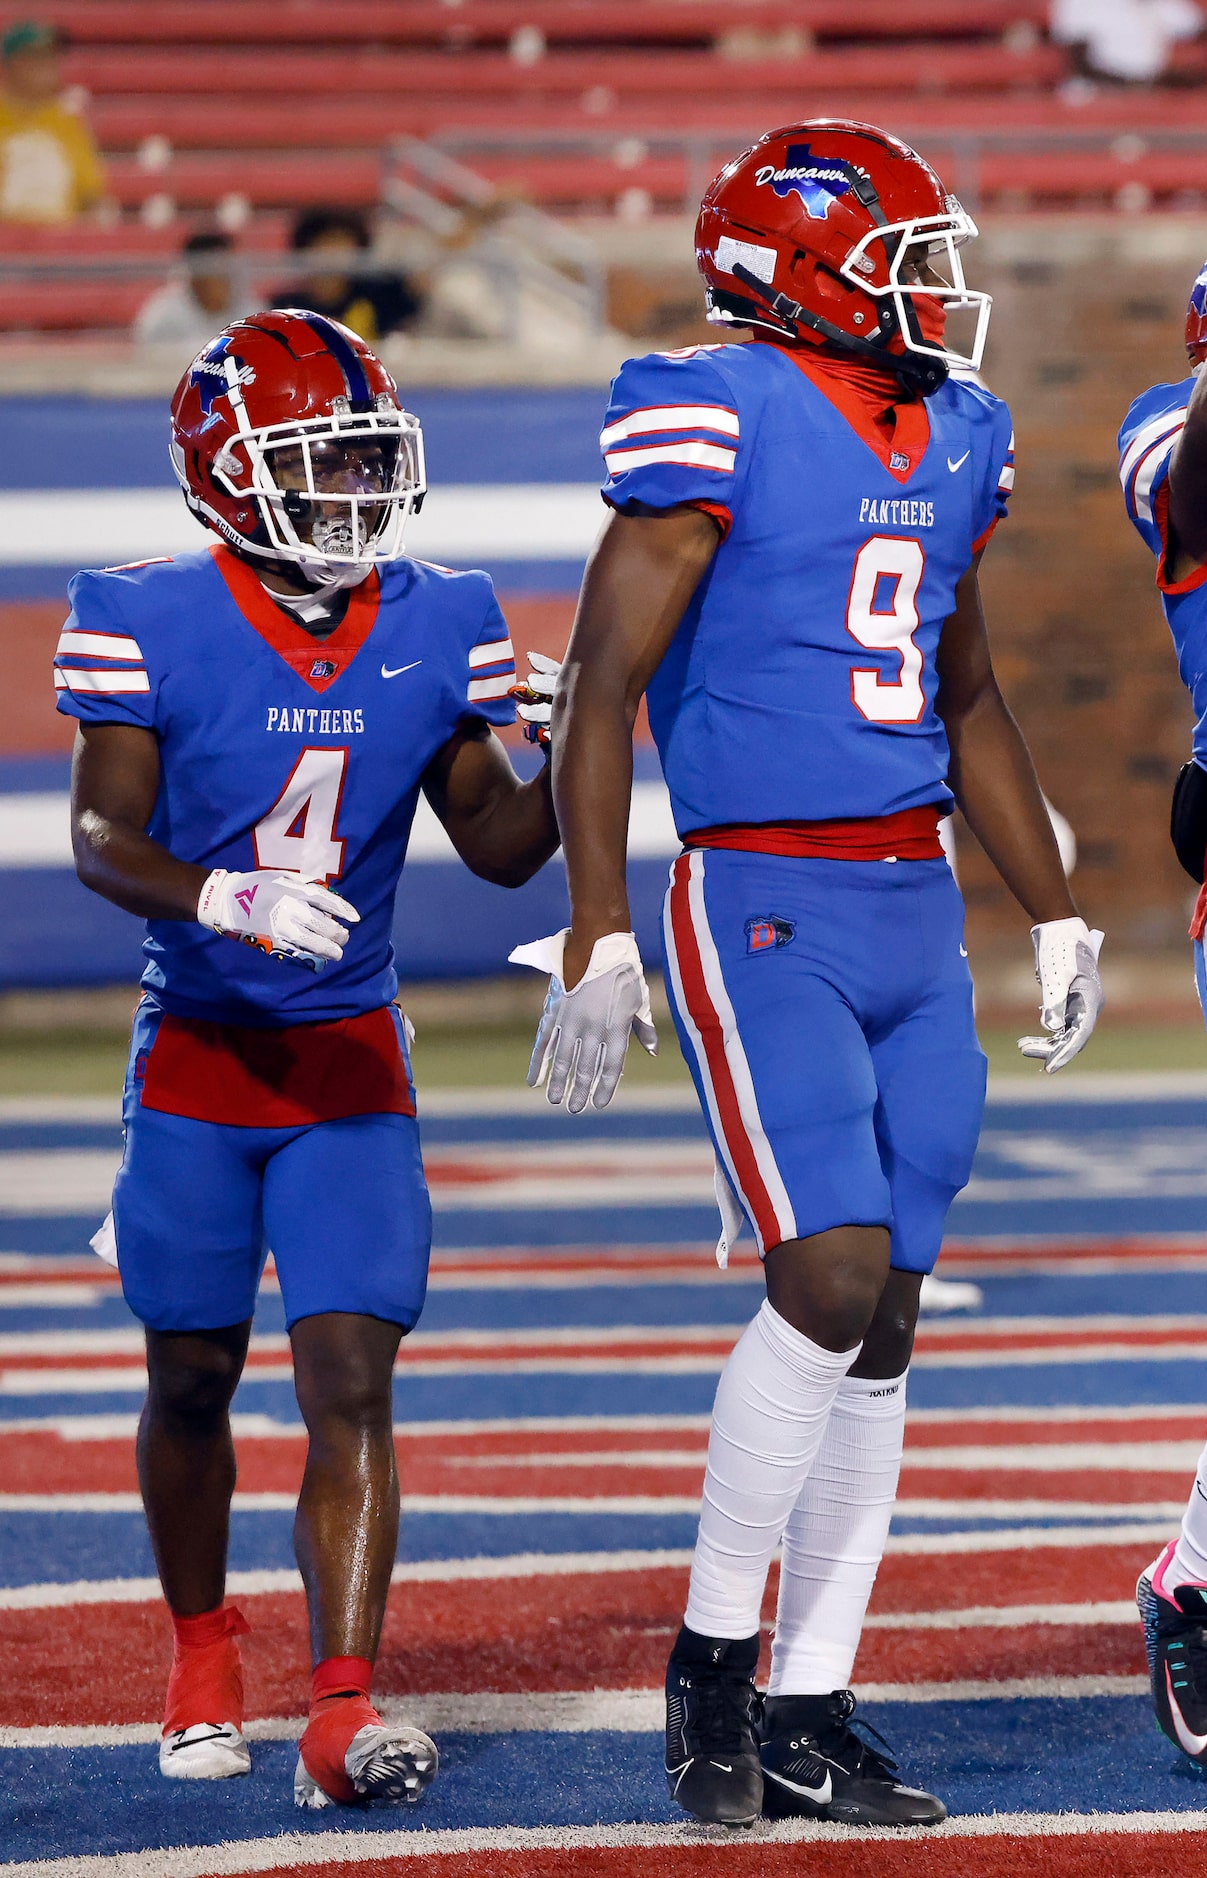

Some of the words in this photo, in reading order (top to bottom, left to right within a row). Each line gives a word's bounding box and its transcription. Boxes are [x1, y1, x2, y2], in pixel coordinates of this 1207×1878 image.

[858, 498, 935, 527] PANTHERS
[844, 533, 927, 724] 9
[266, 707, 364, 734] PANTHERS
[251, 745, 350, 885] 4
